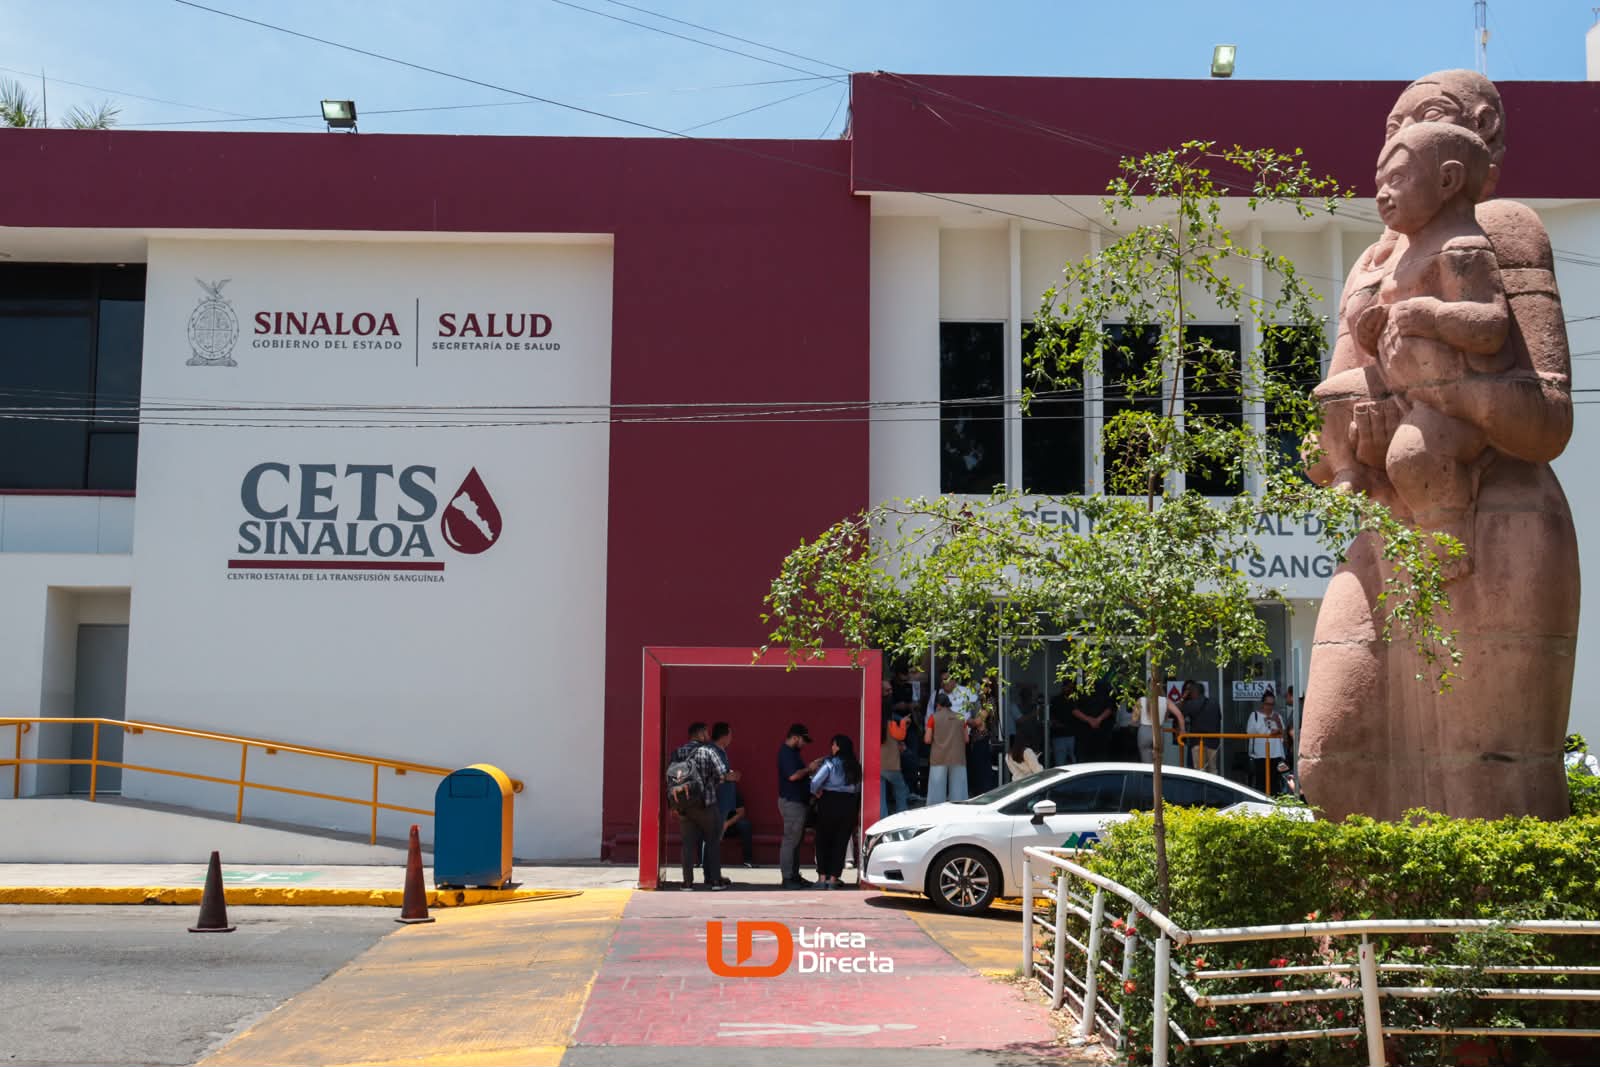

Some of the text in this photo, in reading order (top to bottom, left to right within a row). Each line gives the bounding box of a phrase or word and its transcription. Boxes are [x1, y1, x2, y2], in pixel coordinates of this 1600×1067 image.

[254, 312, 400, 336] SINALOA
[438, 312, 552, 338] SALUD
[252, 339, 402, 350] GOBIERNO DEL ESTADO
[431, 340, 561, 351] SECRETARÍA DE SALUD
[240, 462, 438, 523] CETS
[237, 520, 435, 558] SINALOA
[302, 573, 313, 581] DE
[316, 573, 328, 581] LA
[330, 573, 391, 582] TRANSFUSIÓN
[1248, 554, 1337, 578] SANG
[1235, 682, 1265, 691] CETS
